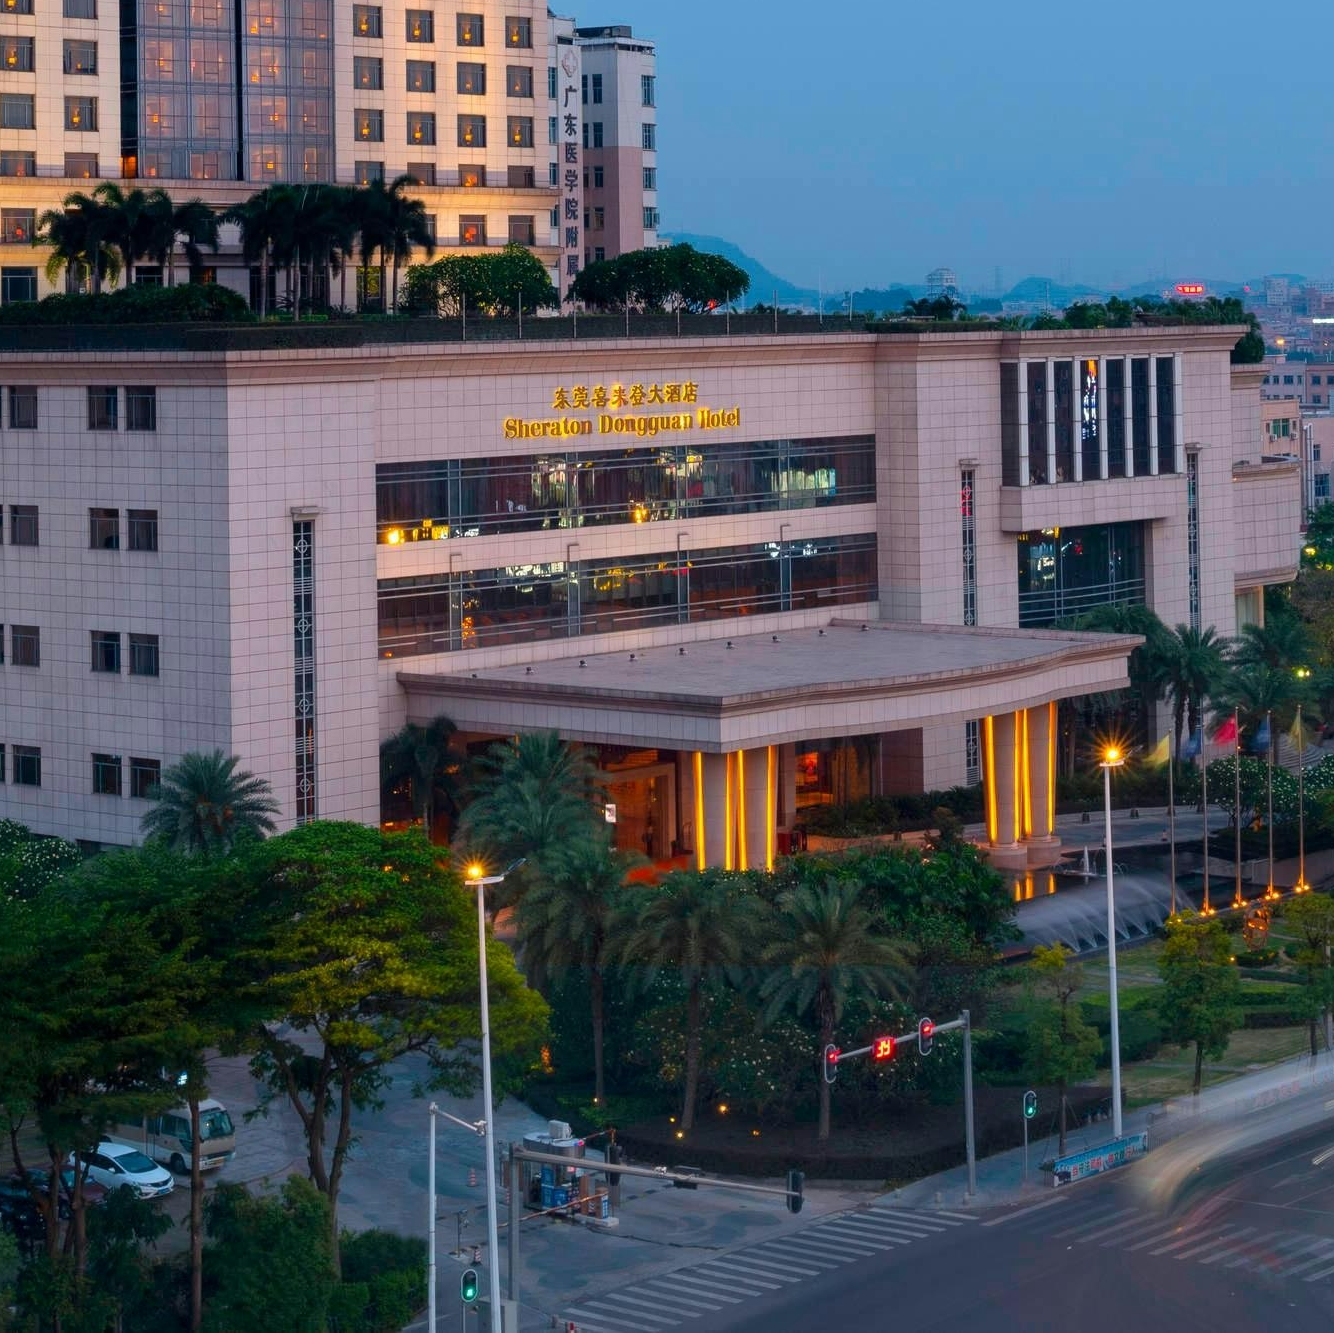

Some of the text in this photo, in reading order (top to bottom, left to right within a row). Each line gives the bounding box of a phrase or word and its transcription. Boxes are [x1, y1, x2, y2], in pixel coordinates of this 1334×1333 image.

[564, 85, 579, 290] 广东医学院附属
[552, 382, 698, 410] 东莞喜来登大酒店
[504, 407, 740, 440] Sheraton Dongguan Hotel
